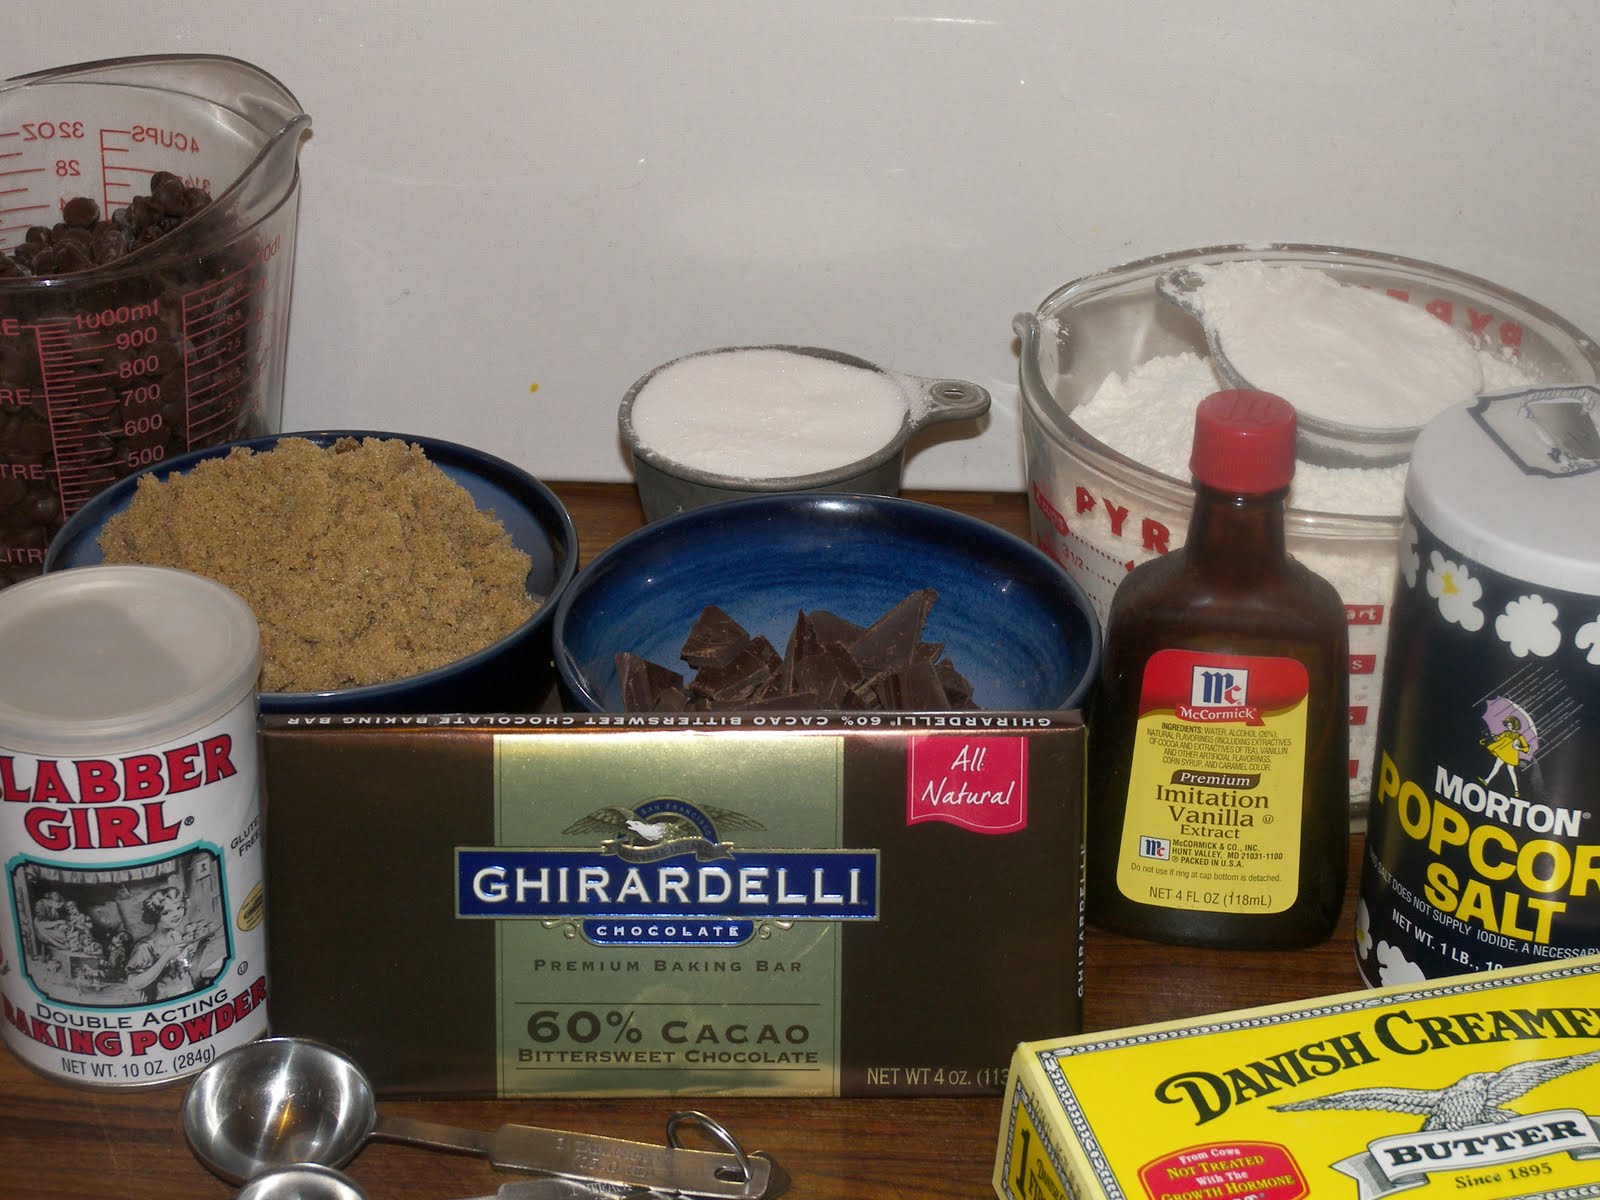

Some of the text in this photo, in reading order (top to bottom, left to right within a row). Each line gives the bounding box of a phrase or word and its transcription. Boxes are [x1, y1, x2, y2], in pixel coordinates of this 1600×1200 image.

[74, 299, 160, 331] 1000ml
[116, 326, 158, 350] 900
[119, 355, 160, 380] 800
[122, 384, 161, 408] 700
[124, 414, 163, 437] 600
[127, 444, 165, 469] 500
[1180, 705, 1255, 721] McCormick
[1146, 728, 1175, 740] NATURAL
[1175, 732, 1214, 743] FLAVORINGS
[1251, 738, 1292, 747] EXTRACTIVES
[1161, 722, 1203, 734] INGREDIENTS:
[1228, 728, 1257, 738] ALCOHOL
[951, 744, 987, 773] All
[1158, 739, 1179, 748] COCOA
[1179, 742, 1193, 750] AND
[1193, 743, 1234, 754] EXTRACTIVES
[1260, 746, 1289, 755] VANILLIN
[1163, 748, 1178, 757] AND
[1177, 750, 1199, 759] OTHER
[1199, 752, 1232, 761] ARTIFICIAL
[0, 733, 238, 804] LABBER
[1162, 756, 1181, 765] CORN
[1203, 760, 1218, 769] AND
[1218, 761, 1248, 771] CARAMEL
[921, 776, 1016, 806] Natural
[1179, 772, 1251, 787] Premium
[1155, 784, 1270, 809] Imitation
[1434, 764, 1582, 838] MORTON
[24, 801, 183, 852] GIRL
[639, 801, 713, 836] SAN FRANCISCO
[1168, 805, 1254, 828] Vanilla
[229, 814, 262, 850] GLUTE
[1179, 824, 1241, 839] Extract
[1171, 846, 1192, 857] HUNT
[1227, 851, 1239, 860] MD
[1240, 851, 1284, 861] 21031-1100
[1172, 839, 1217, 851] McCORMICK
[1218, 843, 1225, 851] &
[1244, 844, 1260, 852] INC.
[1131, 862, 1141, 871] Do
[1142, 864, 1154, 874] not
[1155, 867, 1168, 876] use
[1175, 869, 1190, 881] ring
[1190, 871, 1199, 879] at
[1199, 872, 1213, 882] cap
[1213, 872, 1239, 882] bottom
[1240, 873, 1247, 882] is
[1248, 873, 1283, 883] detached.
[1180, 856, 1245, 869] PACKED IN U.S.A.
[472, 865, 861, 905] GHIRARDELLI
[1149, 885, 1273, 908] NET 4 FL OZ (118mL)
[1423, 862, 1567, 945] SALT
[1391, 879, 1413, 905] DOES
[1412, 895, 1432, 917] NOT
[1432, 908, 1472, 937] SUPPLY
[1476, 929, 1519, 953] IODIDE,
[1520, 941, 1531, 954] A
[595, 924, 741, 938] CHOCOLATE
[1391, 907, 1412, 934] NET
[1414, 923, 1436, 950] WT.
[1440, 942, 1448, 955] 1
[534, 959, 802, 973] PREMIUM BAKING BAR
[36, 989, 229, 1030] DOUBLE ACTING
[129, 975, 267, 1057] POWDER
[526, 1009, 811, 1046] 60% CACAO
[61, 1044, 217, 1078] NET WT. 10 OZ. (284g)
[517, 1048, 820, 1065] BITTERSWEET CHOCOLATE
[1154, 1009, 1600, 1127] DANISH CREAME
[867, 1067, 901, 1086] NET
[905, 1067, 931, 1086] WT
[933, 1067, 945, 1086] 4
[1383, 1119, 1587, 1167] BUTTER
[1166, 1154, 1265, 1181] NOT TREATED
[1178, 1148, 1241, 1166] From Cows
[1160, 1174, 1295, 1200] GROWTH HORMONE
[1195, 1170, 1249, 1187] With The
[1455, 1162, 1553, 1189] Since 1895
